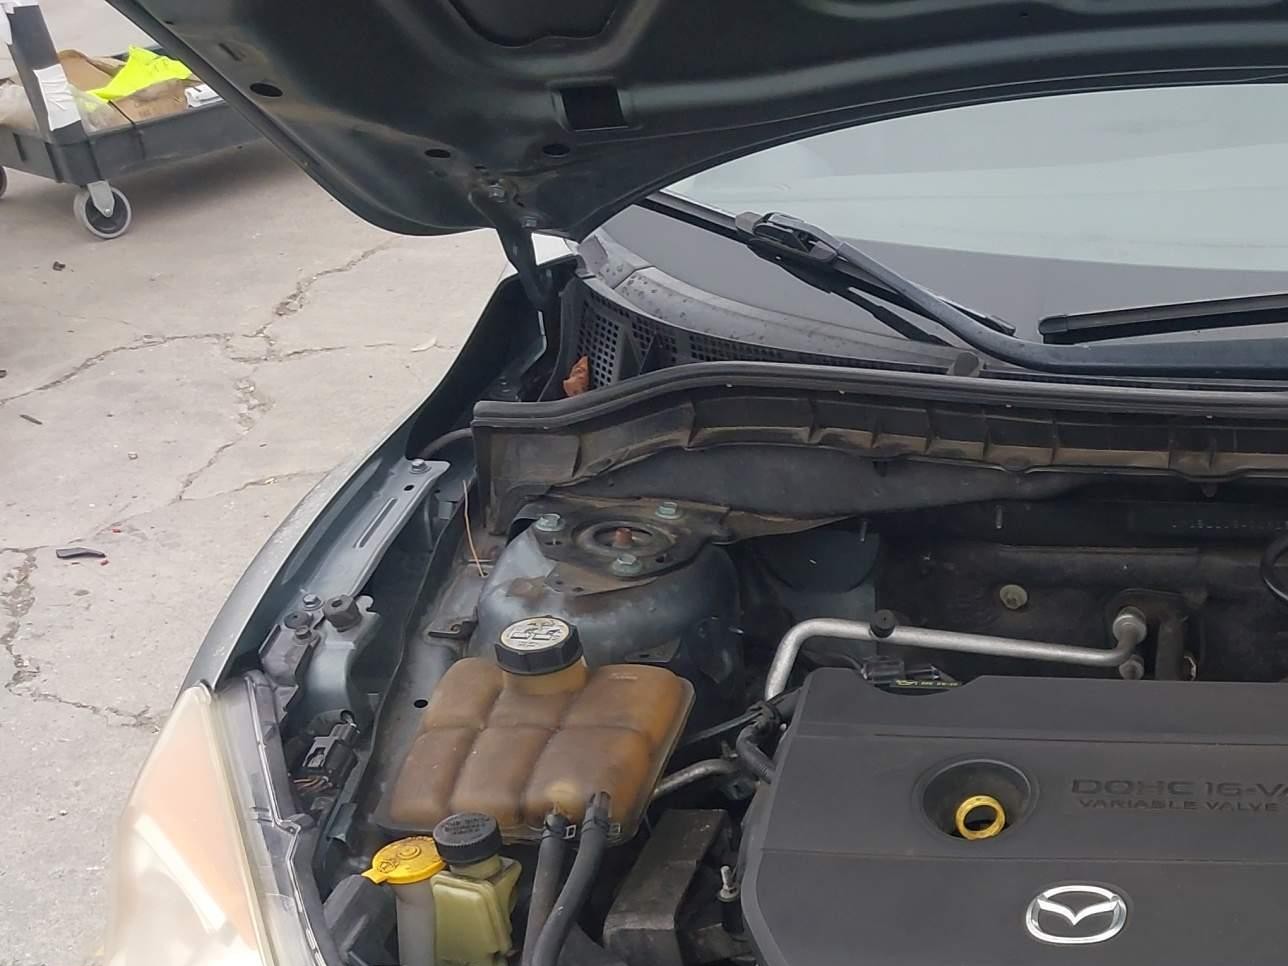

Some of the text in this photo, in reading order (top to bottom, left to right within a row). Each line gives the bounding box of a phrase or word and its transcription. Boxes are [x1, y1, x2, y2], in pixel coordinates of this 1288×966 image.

[1071, 779, 1196, 796] DOHC
[1079, 799, 1198, 811] VARIABLE
[1205, 800, 1279, 812] VALVE
